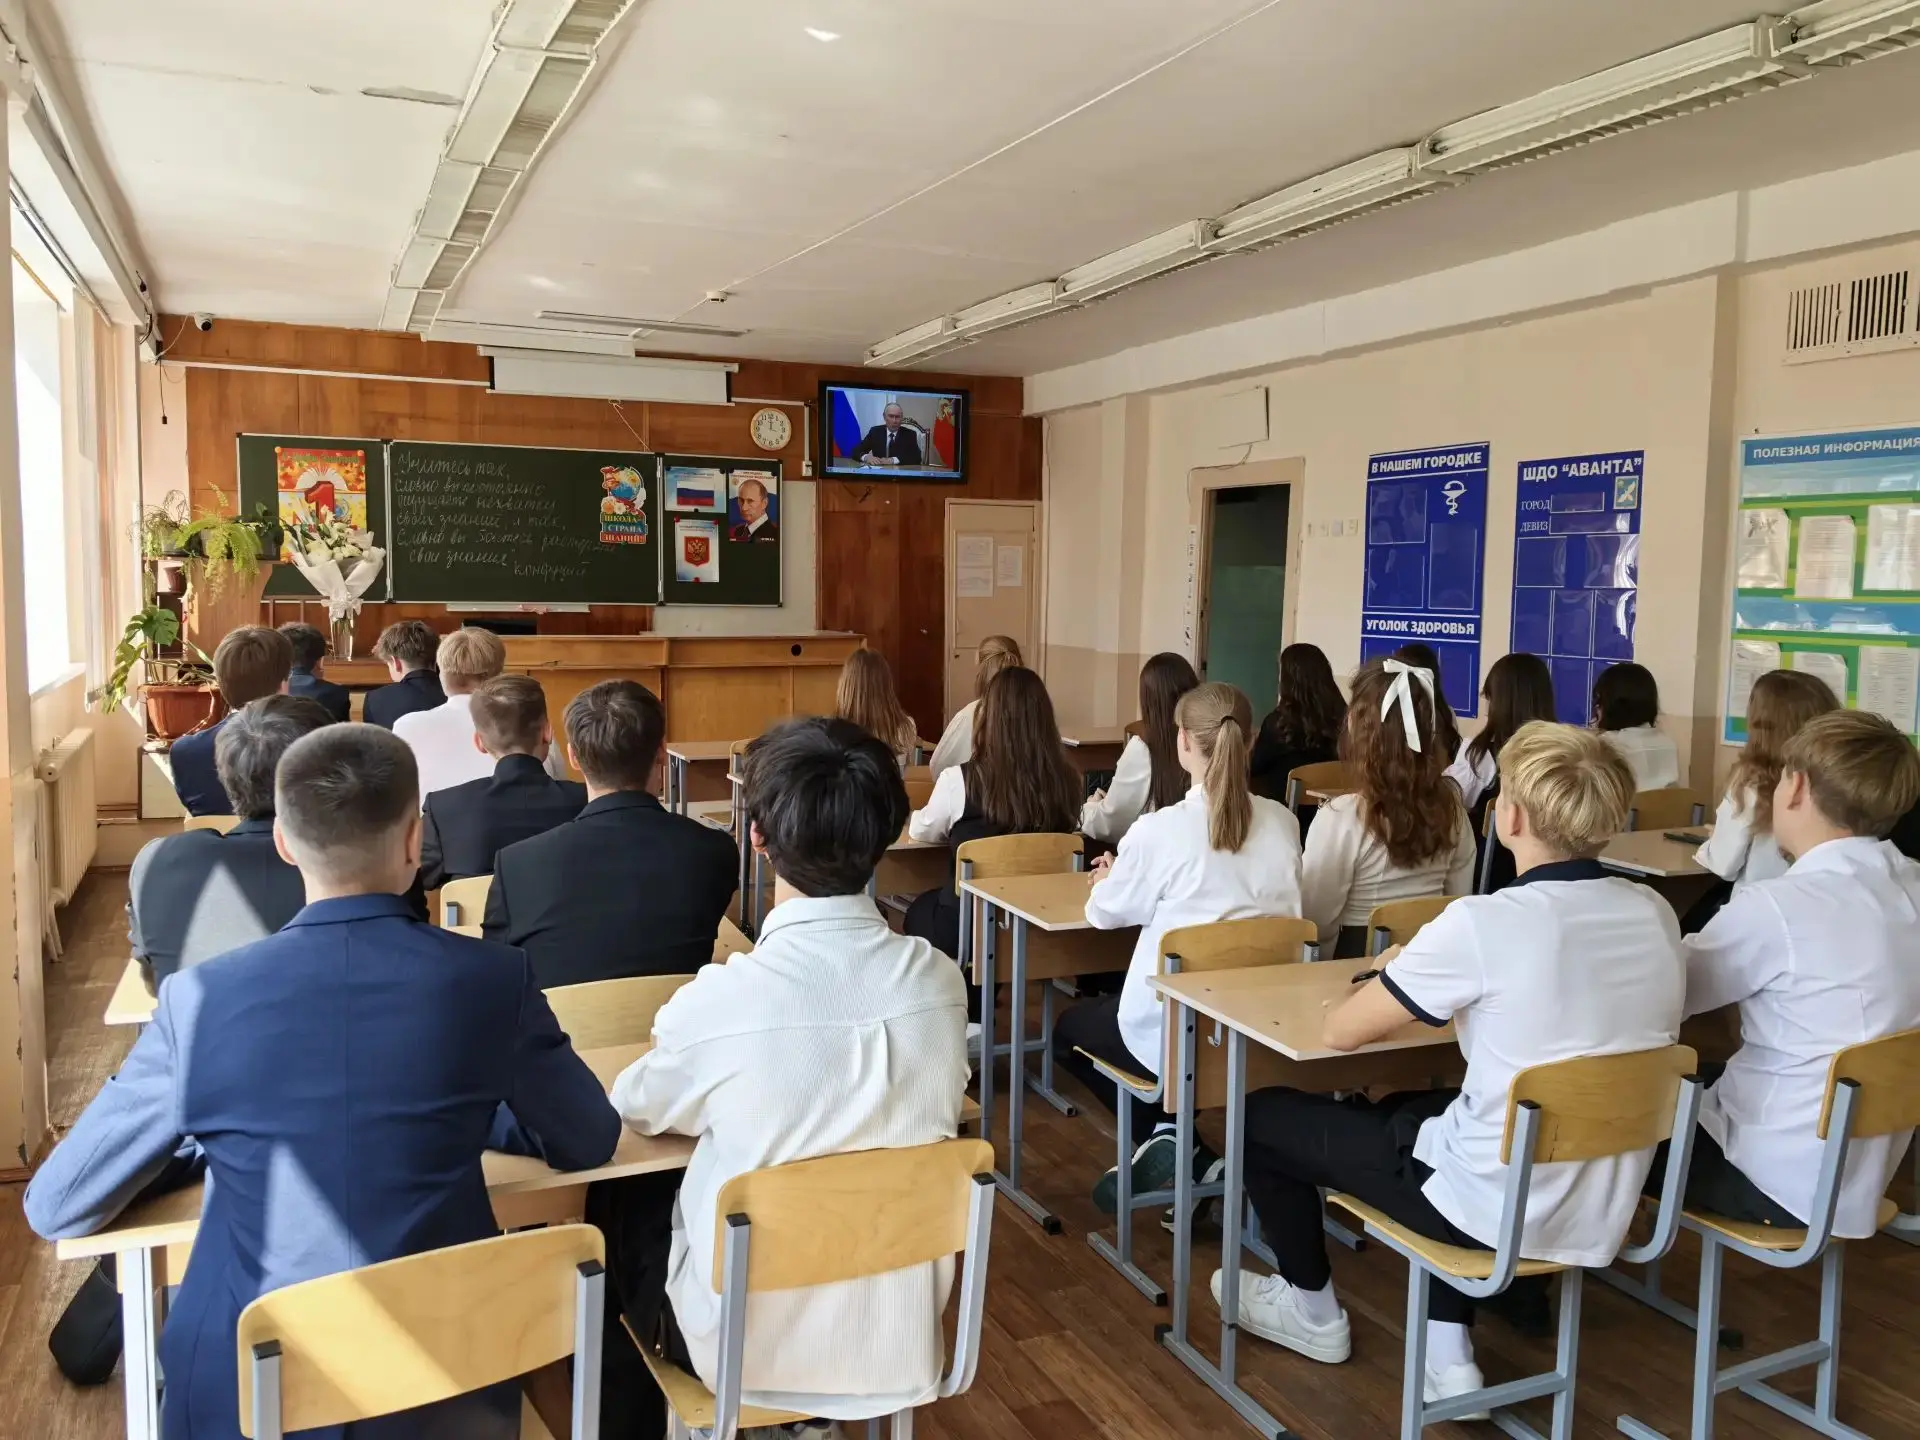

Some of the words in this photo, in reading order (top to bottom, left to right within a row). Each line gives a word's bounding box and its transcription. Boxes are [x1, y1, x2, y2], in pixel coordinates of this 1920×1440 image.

[1753, 445, 1820, 459] ПОЛЕЗНАЯ
[1824, 437, 1920, 453] ИНФОРМАЦИЯ
[1371, 463, 1379, 473] В
[1379, 458, 1422, 473] НАШЕМ
[1423, 452, 1482, 468] ГОРОДКЕ
[1523, 465, 1558, 482] ШДО
[1521, 499, 1550, 510] ГОРОД
[608, 525, 643, 533] СТРАНА
[1520, 521, 1549, 532] ДЕВИЗ
[1366, 619, 1409, 632] УГОЛОК
[1410, 621, 1475, 635] ЗДОРОВЬЯ
